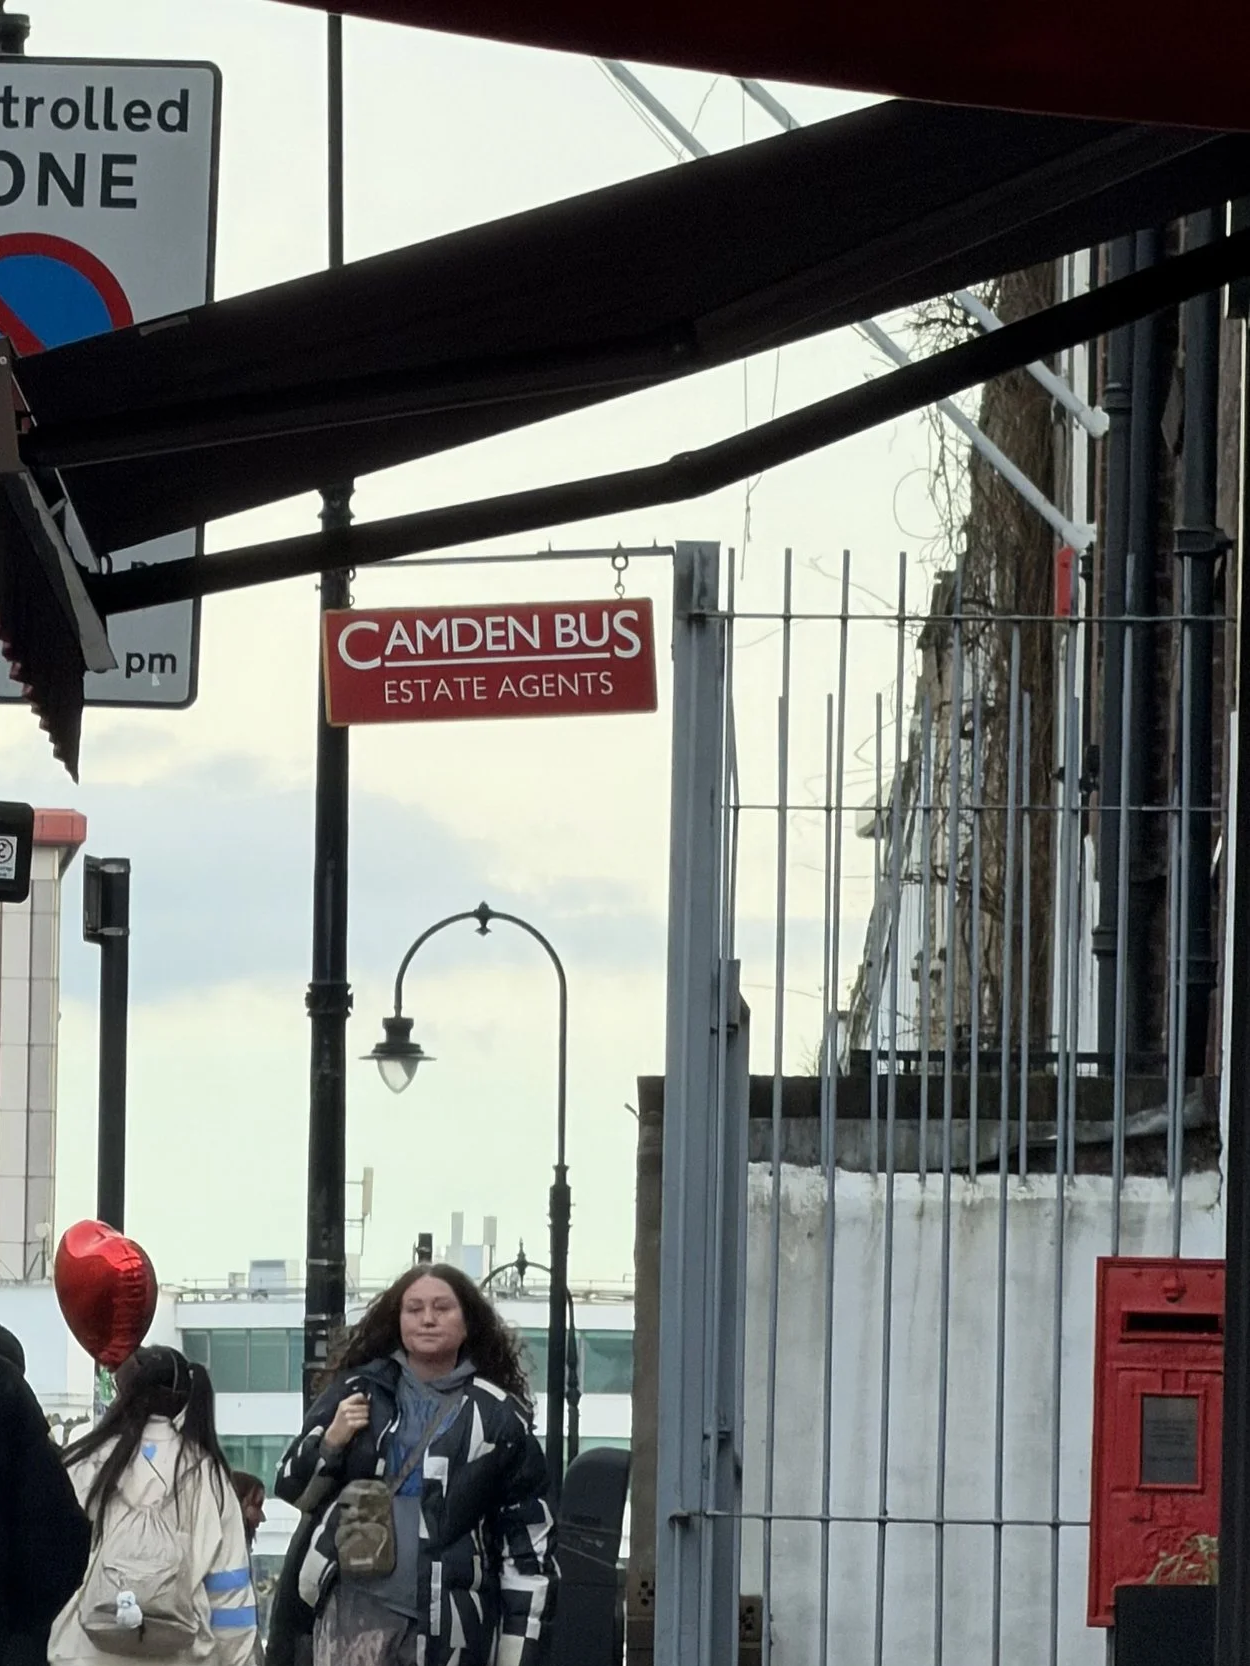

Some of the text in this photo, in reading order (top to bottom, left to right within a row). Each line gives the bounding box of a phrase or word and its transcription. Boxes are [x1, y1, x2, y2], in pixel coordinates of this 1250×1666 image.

[337, 609, 642, 670] CAMDEN BUS
[125, 650, 177, 679] pm
[384, 671, 614, 704] ESTATE AGENTS
